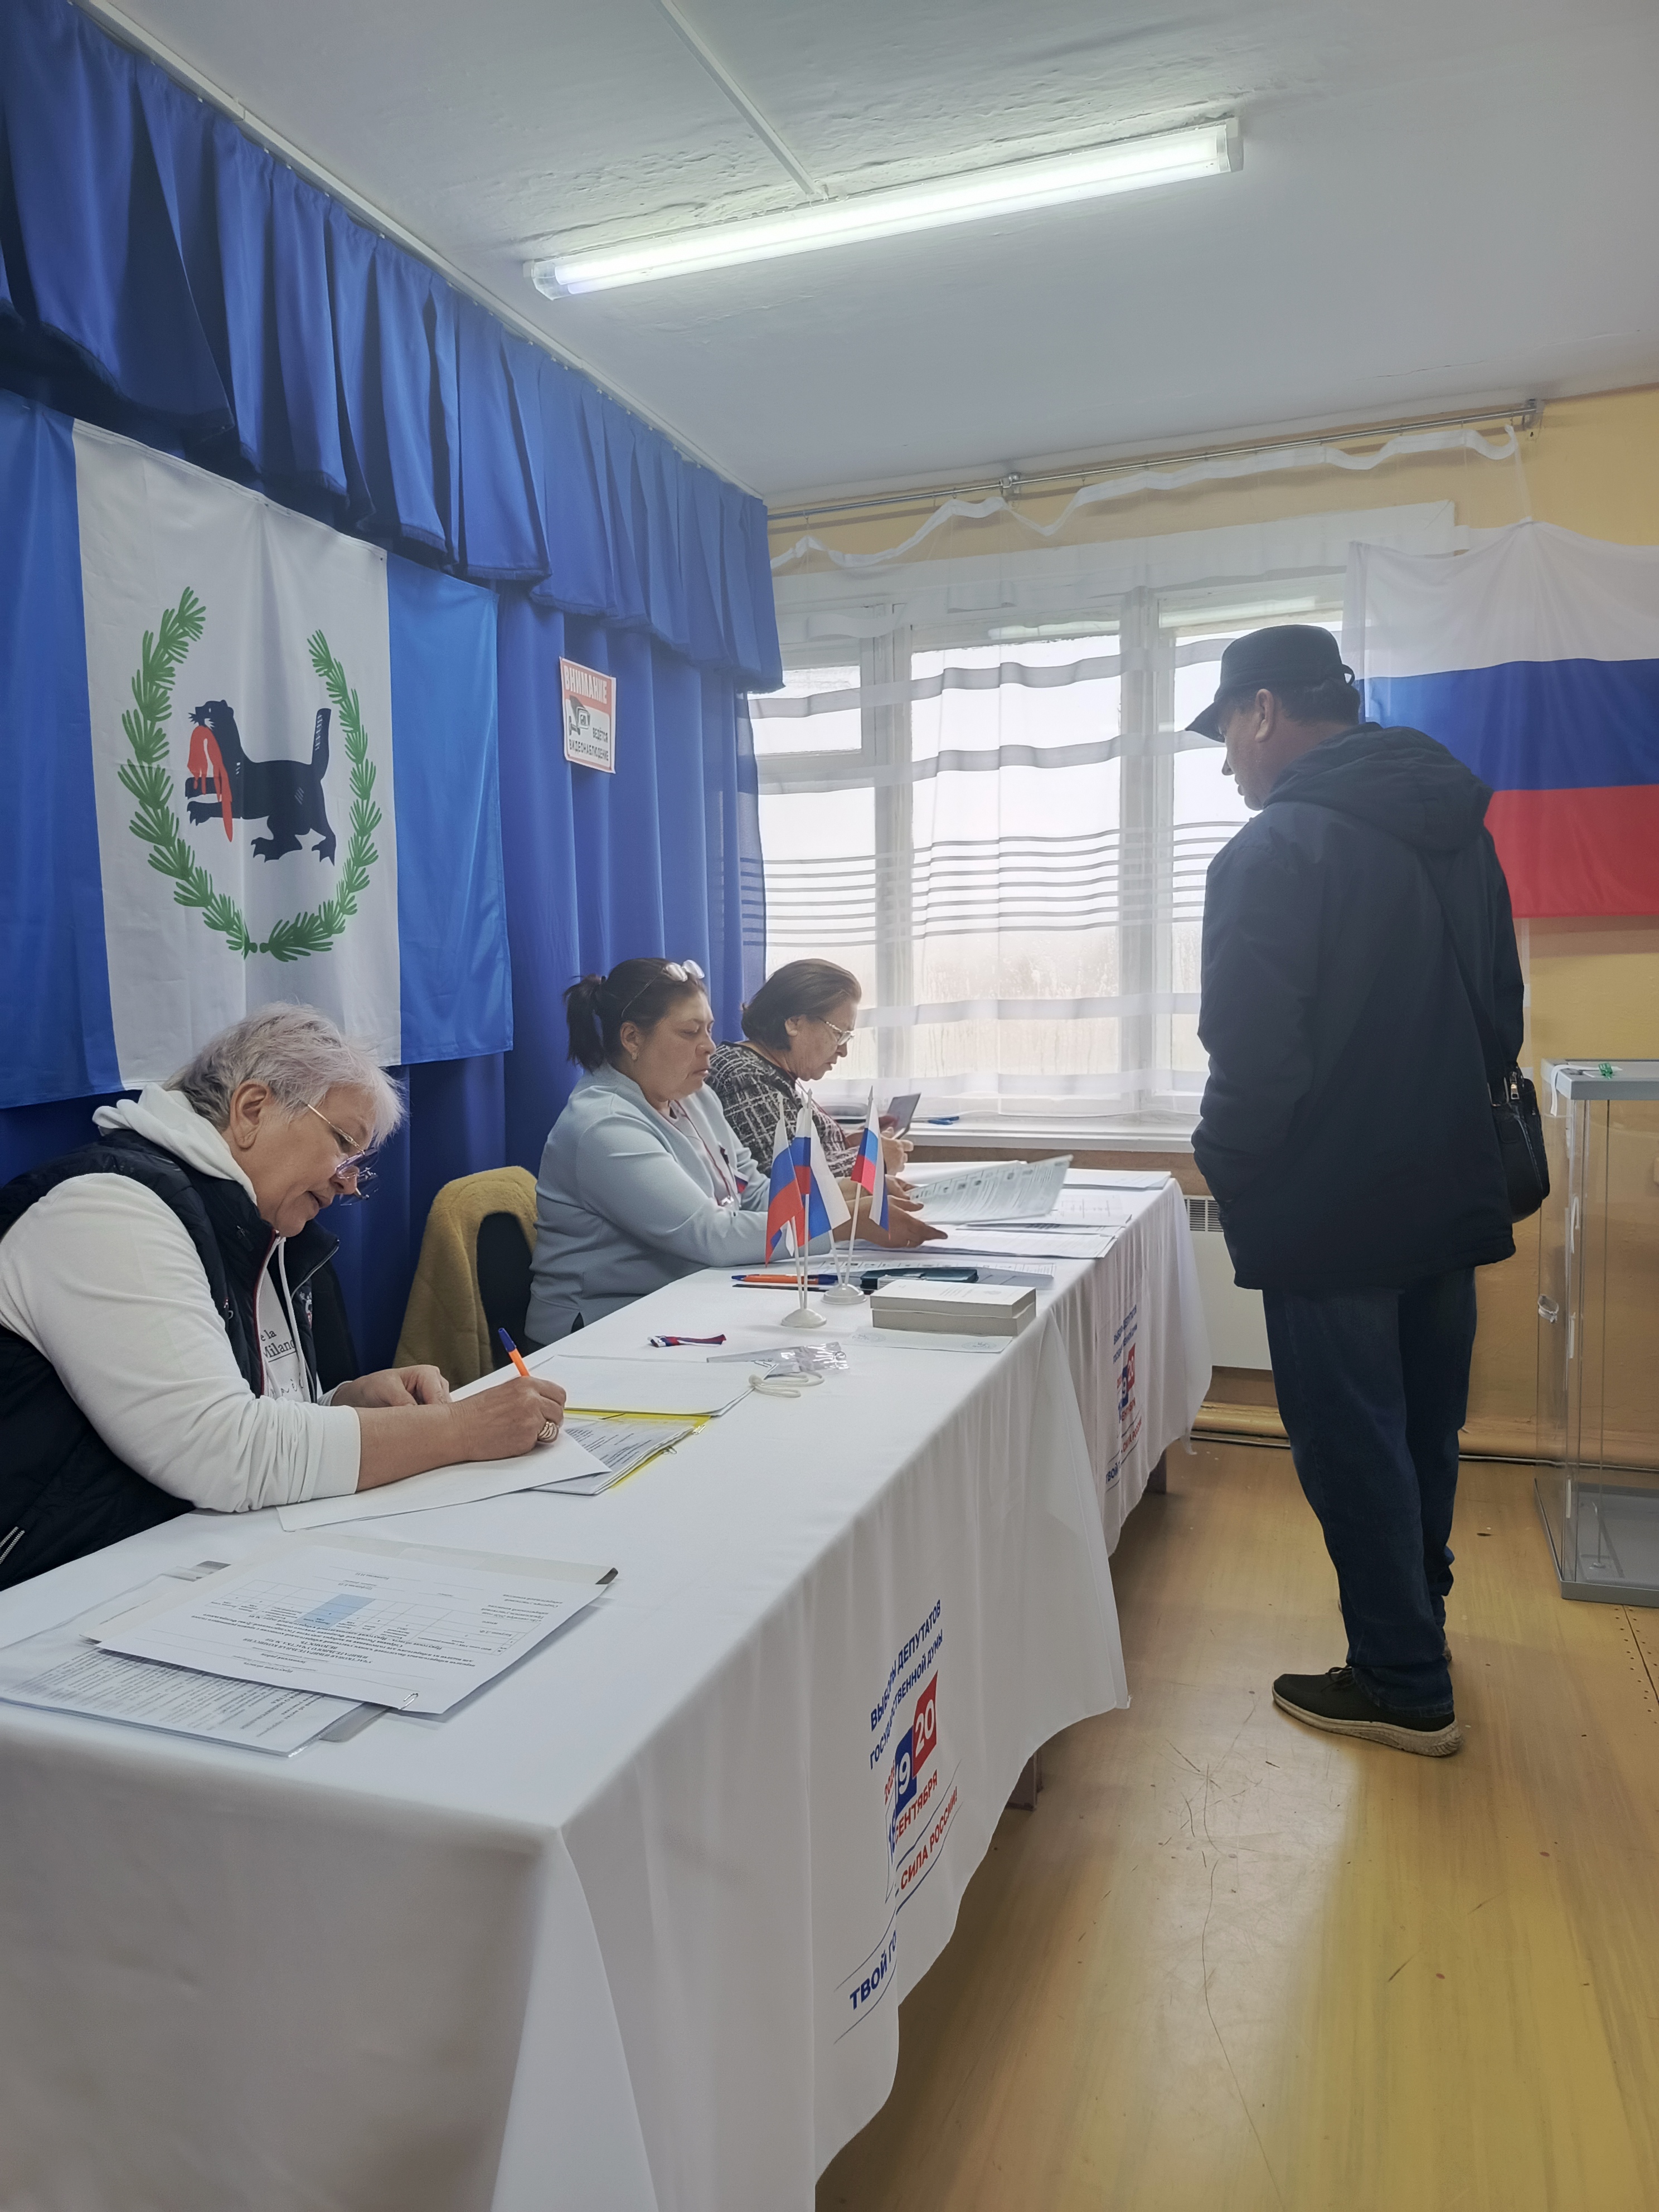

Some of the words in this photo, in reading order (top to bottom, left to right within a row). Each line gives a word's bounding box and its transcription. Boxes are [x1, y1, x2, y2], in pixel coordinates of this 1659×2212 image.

[564, 665, 607, 704] ВНИМАНИЕ
[264, 1330, 276, 1339] la
[871, 1659, 896, 1731] ВЫБОРЫ
[898, 1599, 940, 1675] ДЕПУТАТОВ
[928, 1628, 943, 1669] ДУМЫ
[915, 1699, 934, 1758] 20
[895, 1752, 911, 1806] 19
[850, 1949, 887, 2010] ТВОЙ
[901, 1845, 928, 1890] СИЛА
[930, 1786, 958, 1854] РОССИИ!
